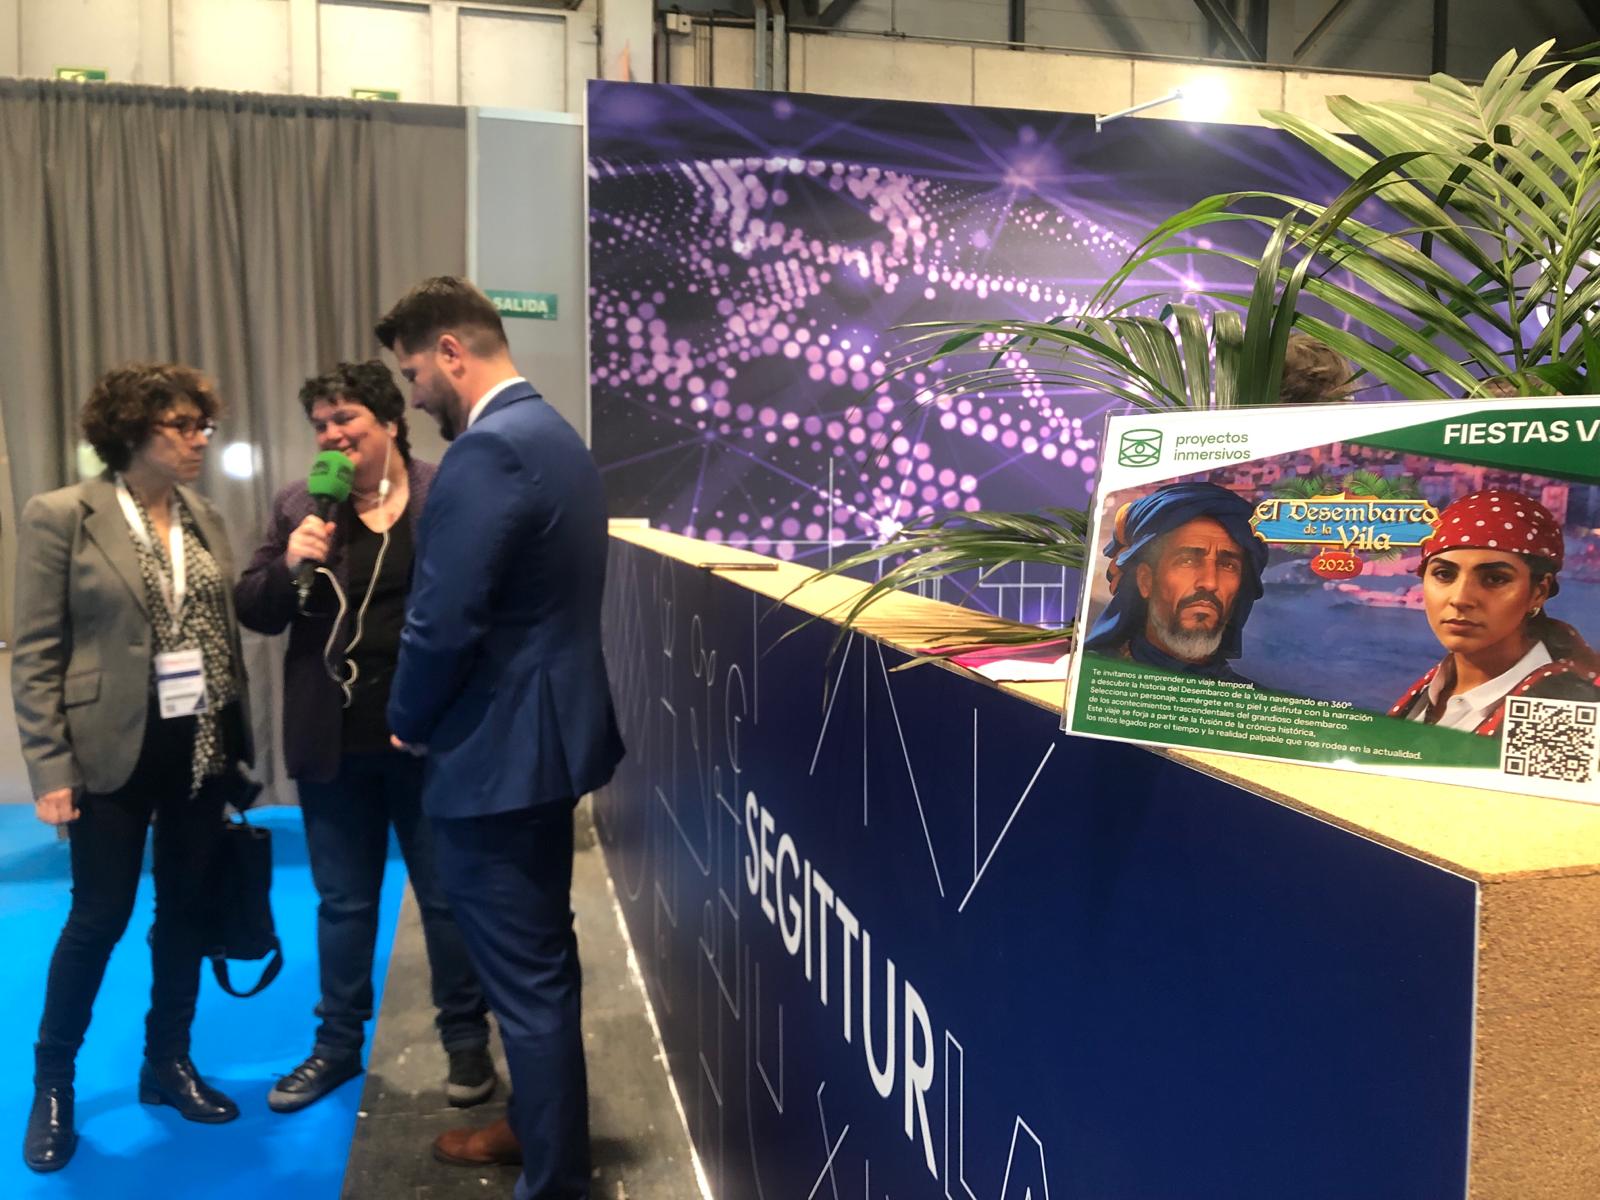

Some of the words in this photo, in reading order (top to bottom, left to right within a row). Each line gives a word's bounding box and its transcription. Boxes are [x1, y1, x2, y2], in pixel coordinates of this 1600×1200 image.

[493, 297, 548, 312] SALIDA
[1176, 431, 1249, 447] proyectos
[1443, 420, 1570, 445] FIESTAS
[1173, 448, 1251, 461] inmersivos
[1256, 500, 1280, 520] El
[1287, 501, 1439, 522] Desembarco
[1303, 523, 1317, 535] de
[1321, 523, 1332, 535] la
[1336, 524, 1392, 551] Vila
[1318, 559, 1355, 572] 2023
[1092, 668, 1101, 676] Te
[1103, 670, 1136, 679] invitamos
[1144, 674, 1185, 683] emprender
[1198, 679, 1215, 687] viaje
[1090, 686, 1128, 696] Selecciona
[1180, 696, 1221, 706] sumérgete
[1247, 703, 1262, 711] piel
[1271, 705, 1302, 714] disfruta
[1332, 712, 1373, 722] narración
[1097, 679, 1130, 687] descubrir
[1140, 682, 1166, 691] historia
[1181, 686, 1230, 697] Desembarco
[1244, 692, 1251, 700] la
[1254, 693, 1268, 701] Vila
[1270, 696, 1315, 706] navegando
[1105, 707, 1120, 715] viaje
[1132, 710, 1148, 719] forja
[1200, 717, 1223, 726] fusión
[1246, 723, 1276, 732] crónica
[1111, 699, 1171, 711] acontecimientos
[1174, 705, 1234, 718] trascendentales
[1252, 714, 1291, 723] grandioso
[1119, 718, 1147, 727] legados
[1149, 722, 1161, 730] por
[1173, 724, 1199, 734] tiempo
[1216, 730, 1248, 739] realidad
[1250, 734, 1284, 743] palpable
[1286, 738, 1302, 746] que
[1322, 743, 1347, 751] rodea
